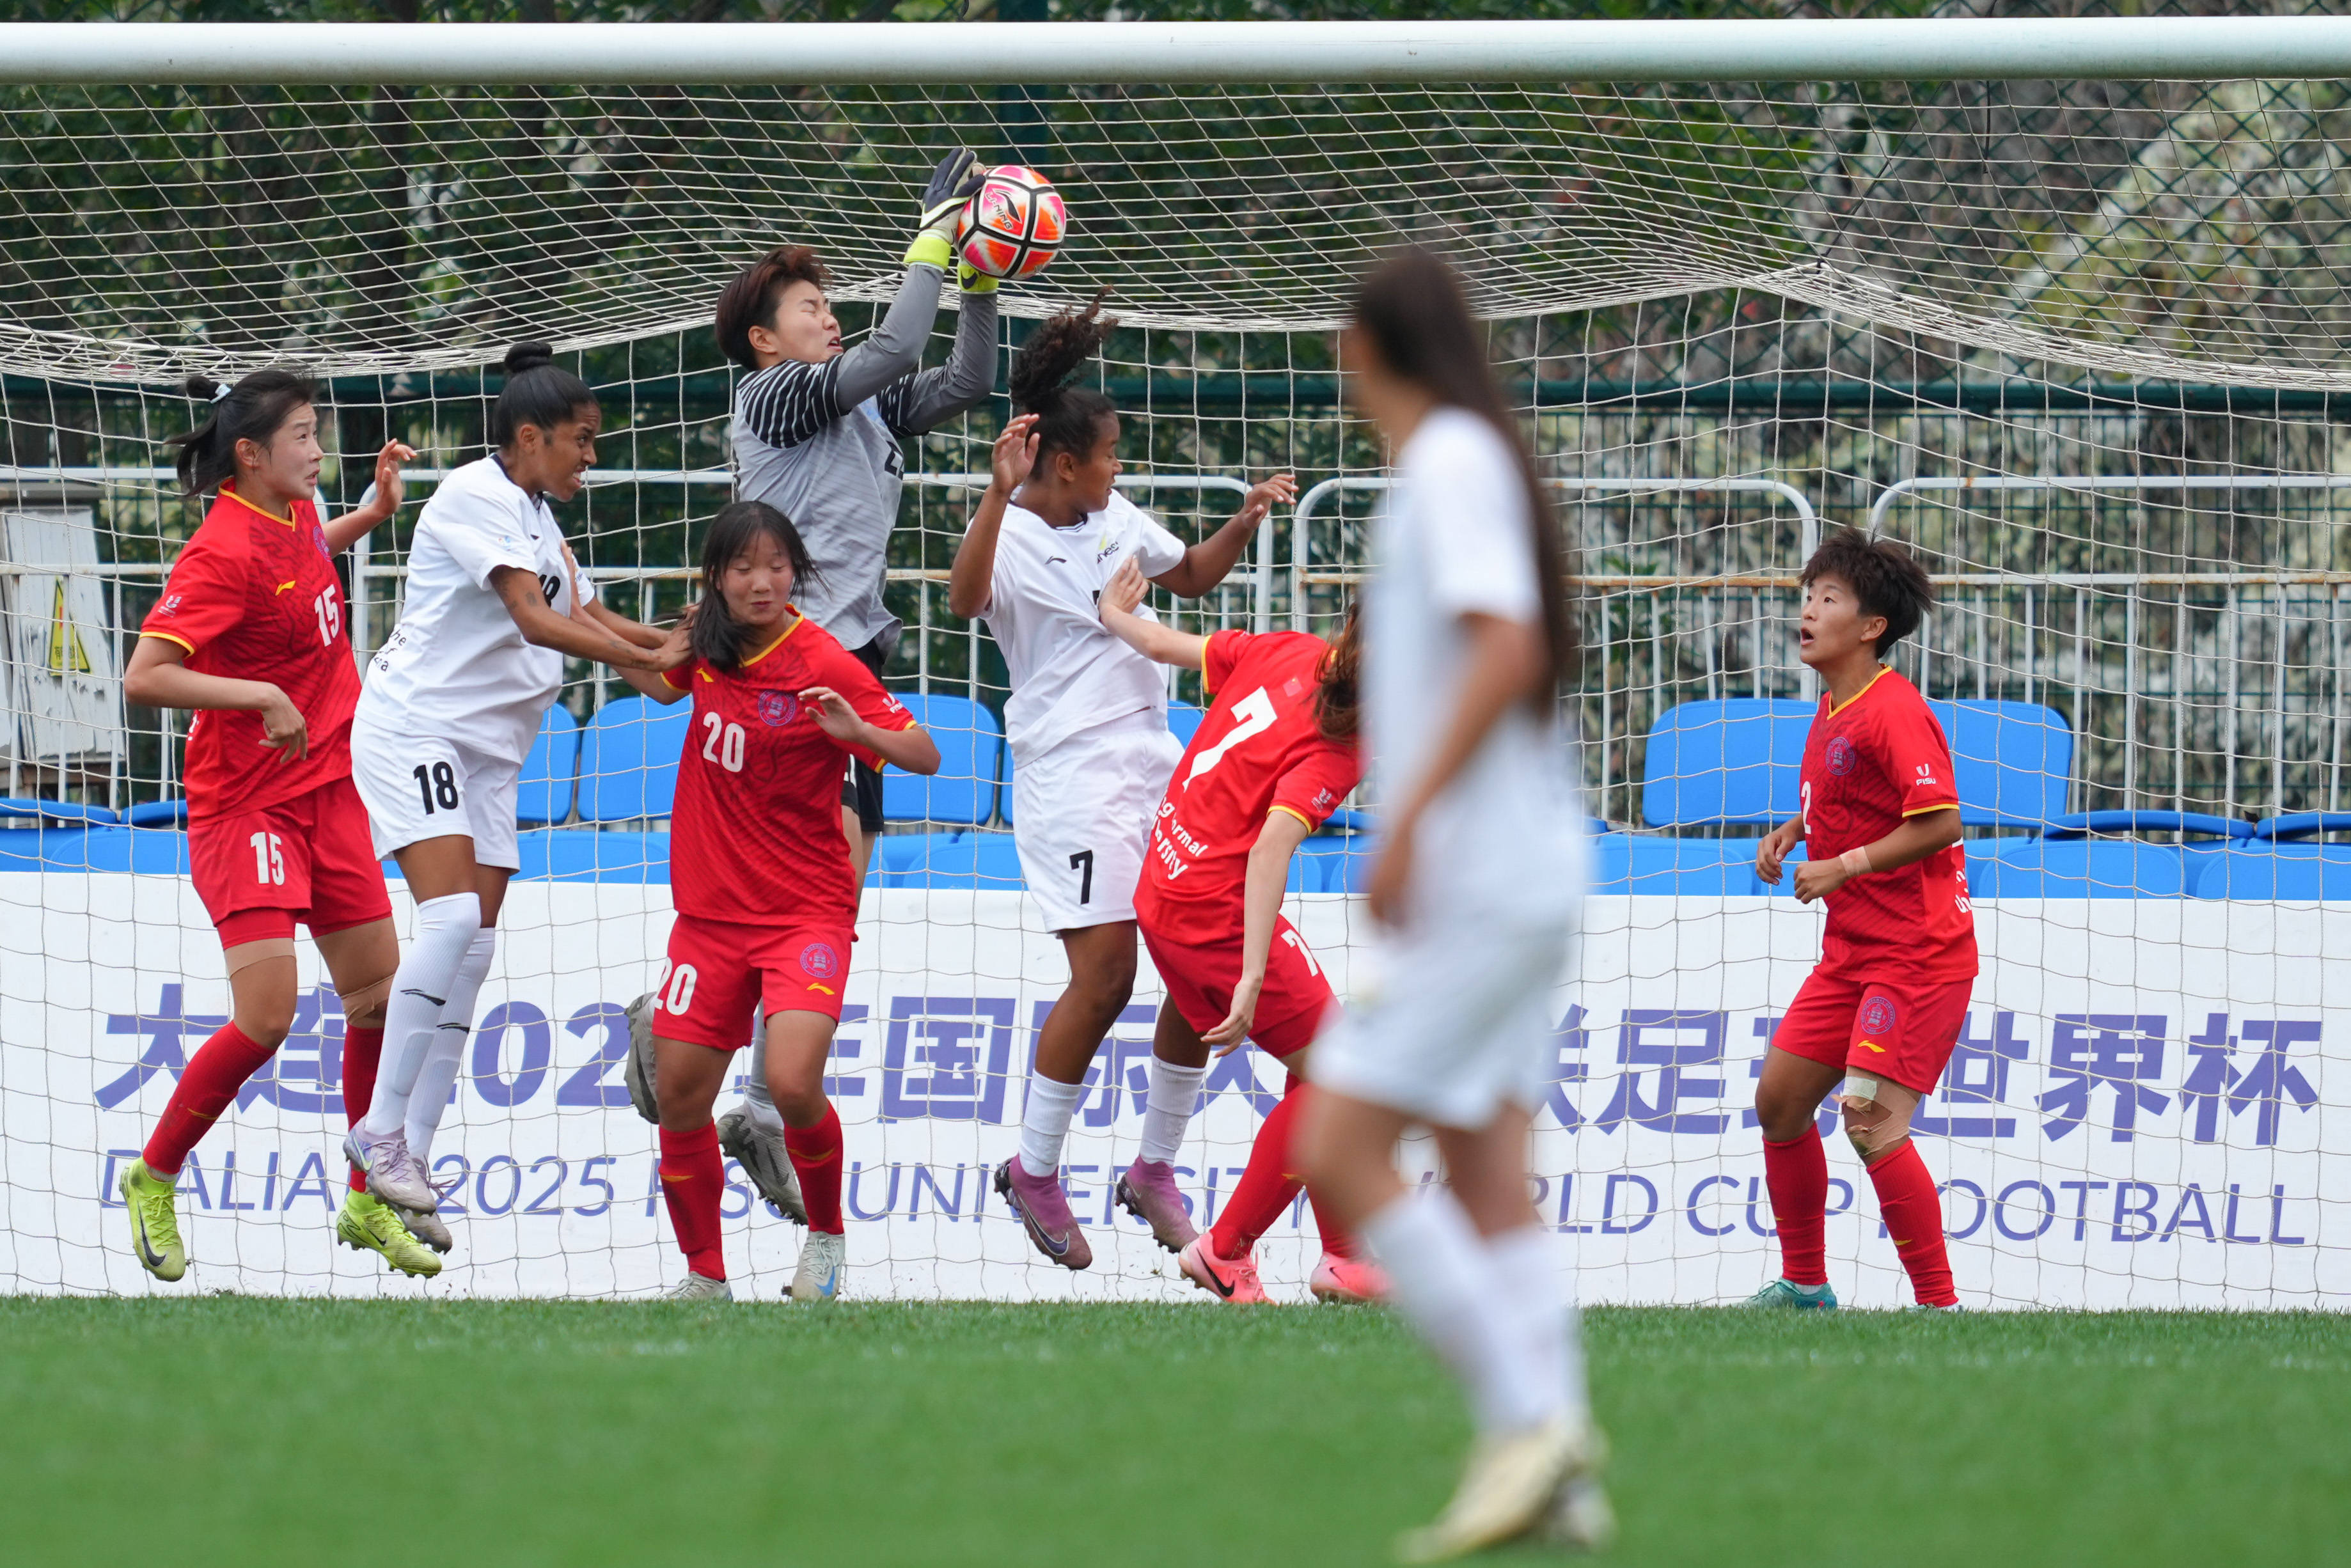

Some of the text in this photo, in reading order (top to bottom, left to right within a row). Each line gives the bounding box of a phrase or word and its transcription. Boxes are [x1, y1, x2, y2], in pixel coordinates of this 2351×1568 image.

[985, 192, 1013, 230] LI-NING
[314, 584, 340, 647] 15
[703, 712, 746, 772] 20
[1182, 686, 1278, 794] 7
[413, 761, 459, 815] 18
[250, 831, 285, 886] 15
[1069, 849, 1094, 905] 7
[654, 956, 698, 1015] 20
[102, 1149, 353, 1212] DALIA
[432, 1154, 617, 1216] 2025
[848, 1161, 1309, 1228] UNIESI
[1878, 1179, 2305, 1245] OOTBALL
